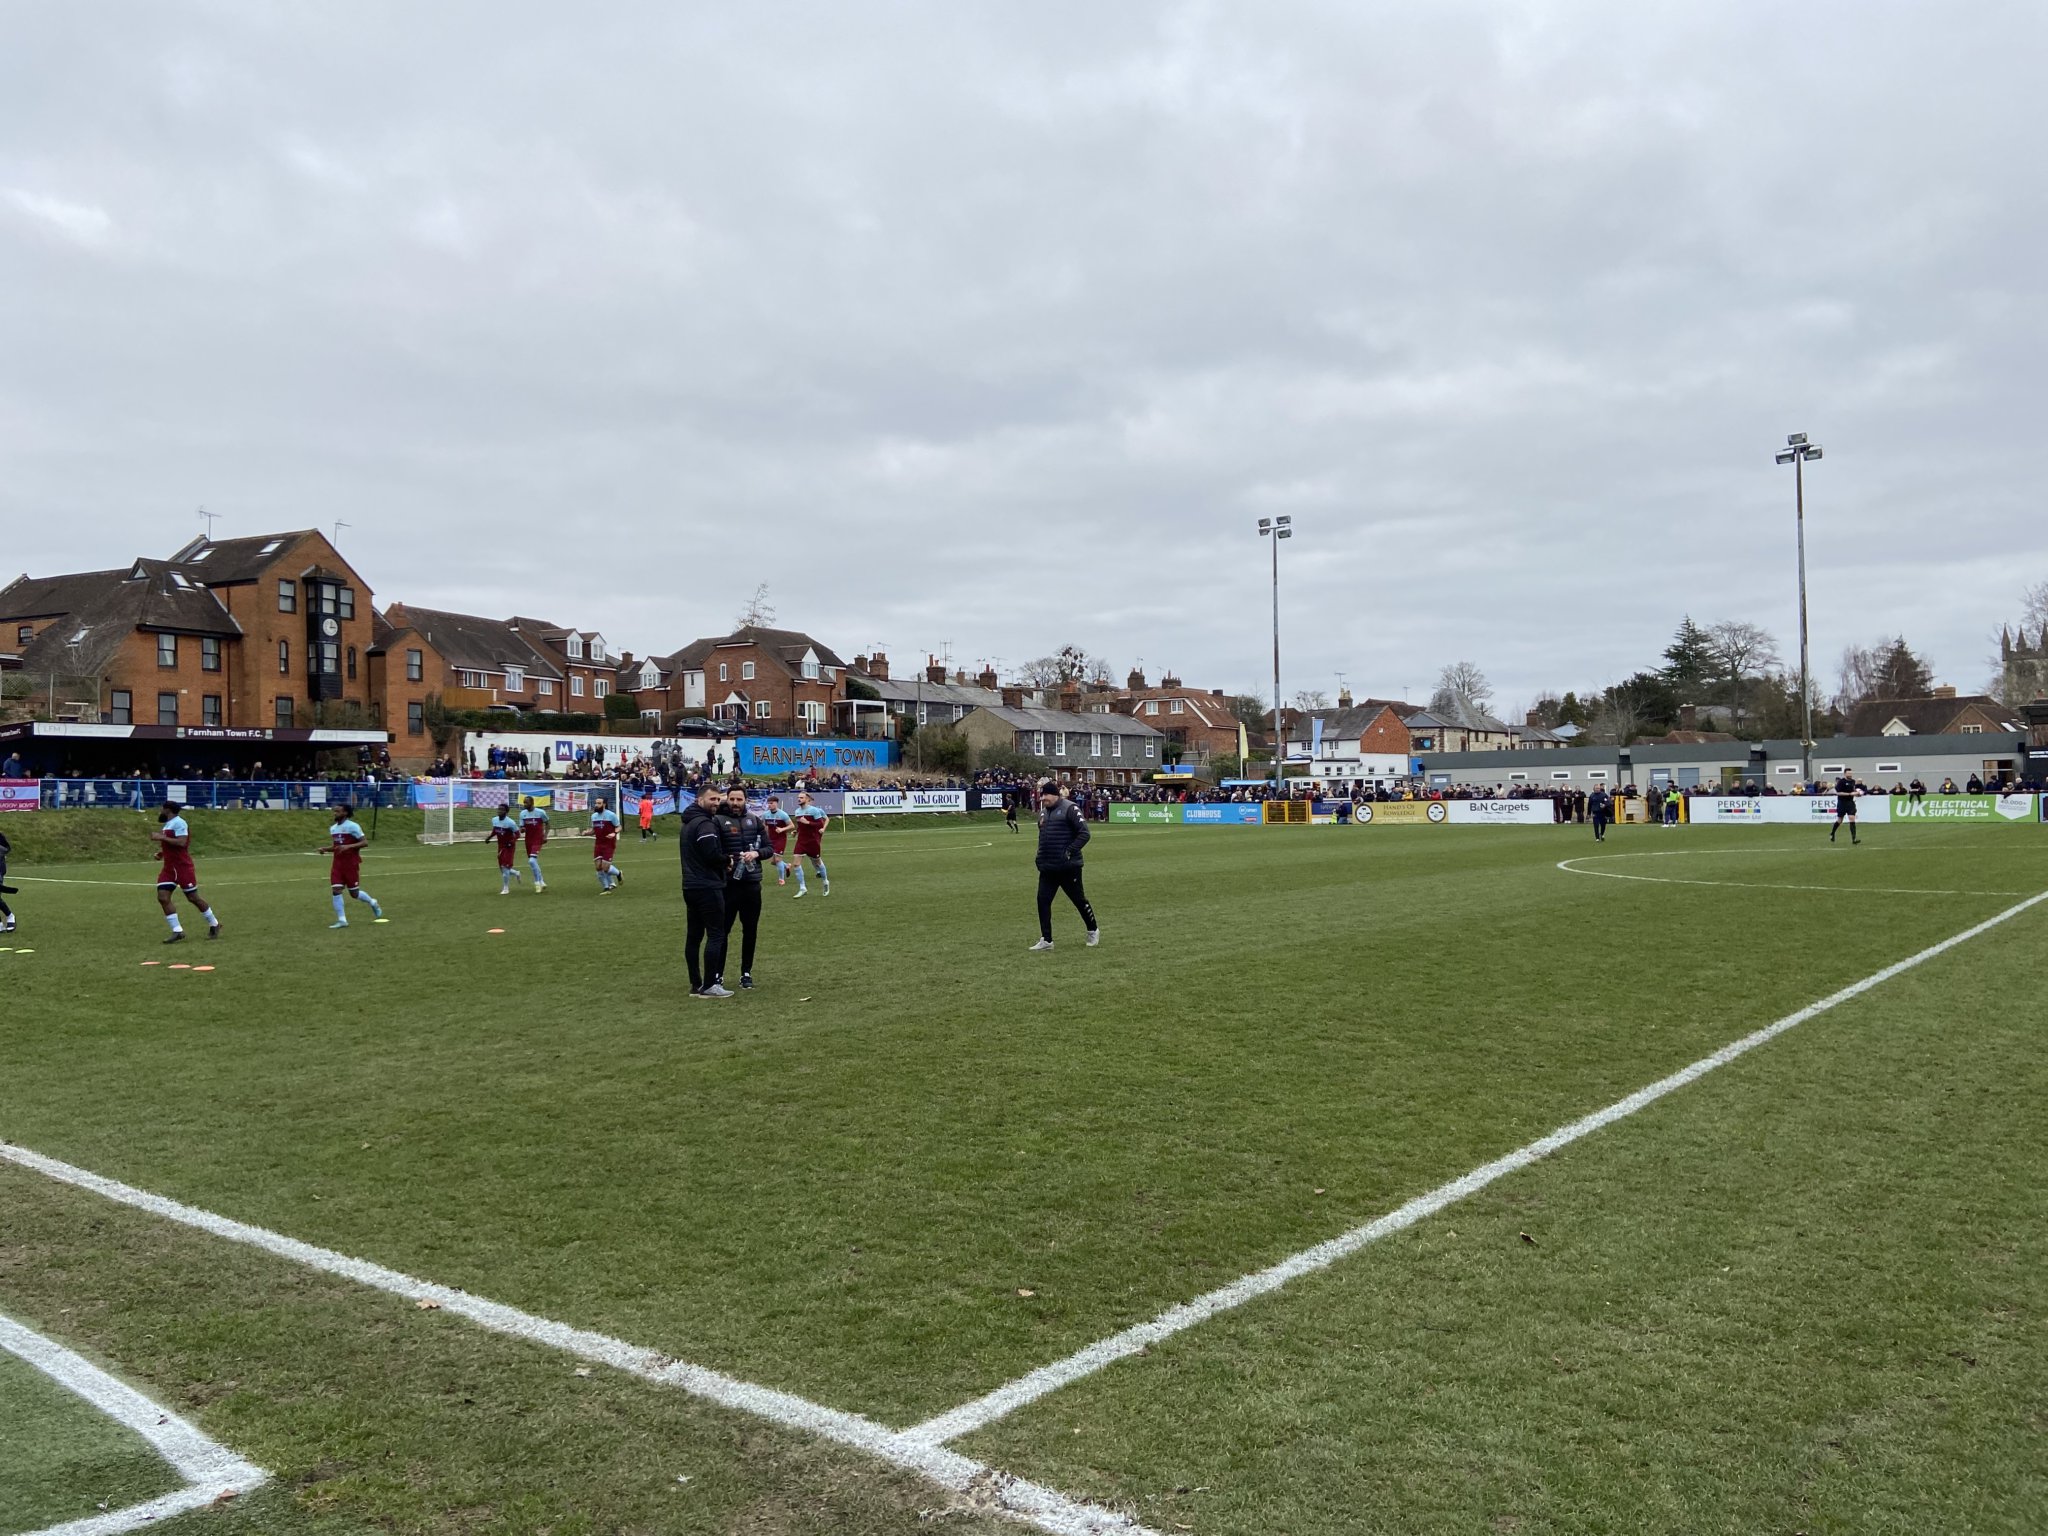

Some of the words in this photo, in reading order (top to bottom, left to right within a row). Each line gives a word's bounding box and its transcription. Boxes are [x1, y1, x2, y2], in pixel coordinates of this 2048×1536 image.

[188, 728, 224, 737] Farnham
[226, 729, 247, 737] Town
[248, 730, 263, 738] F.C.
[754, 746, 826, 764] FARNHAM
[834, 748, 876, 765] TOWN
[852, 795, 872, 805] MKJ
[873, 794, 903, 805] GROUP
[913, 794, 930, 804] MKJ
[931, 794, 960, 804] GROUP
[1717, 800, 1761, 808] PERSPEX
[1469, 803, 1488, 812] B&N
[1490, 803, 1530, 813] Carpets
[1895, 800, 1929, 817] UK
[1929, 800, 1990, 809] ELECTRICAL
[1186, 810, 1222, 818] CLUBHOUSE
